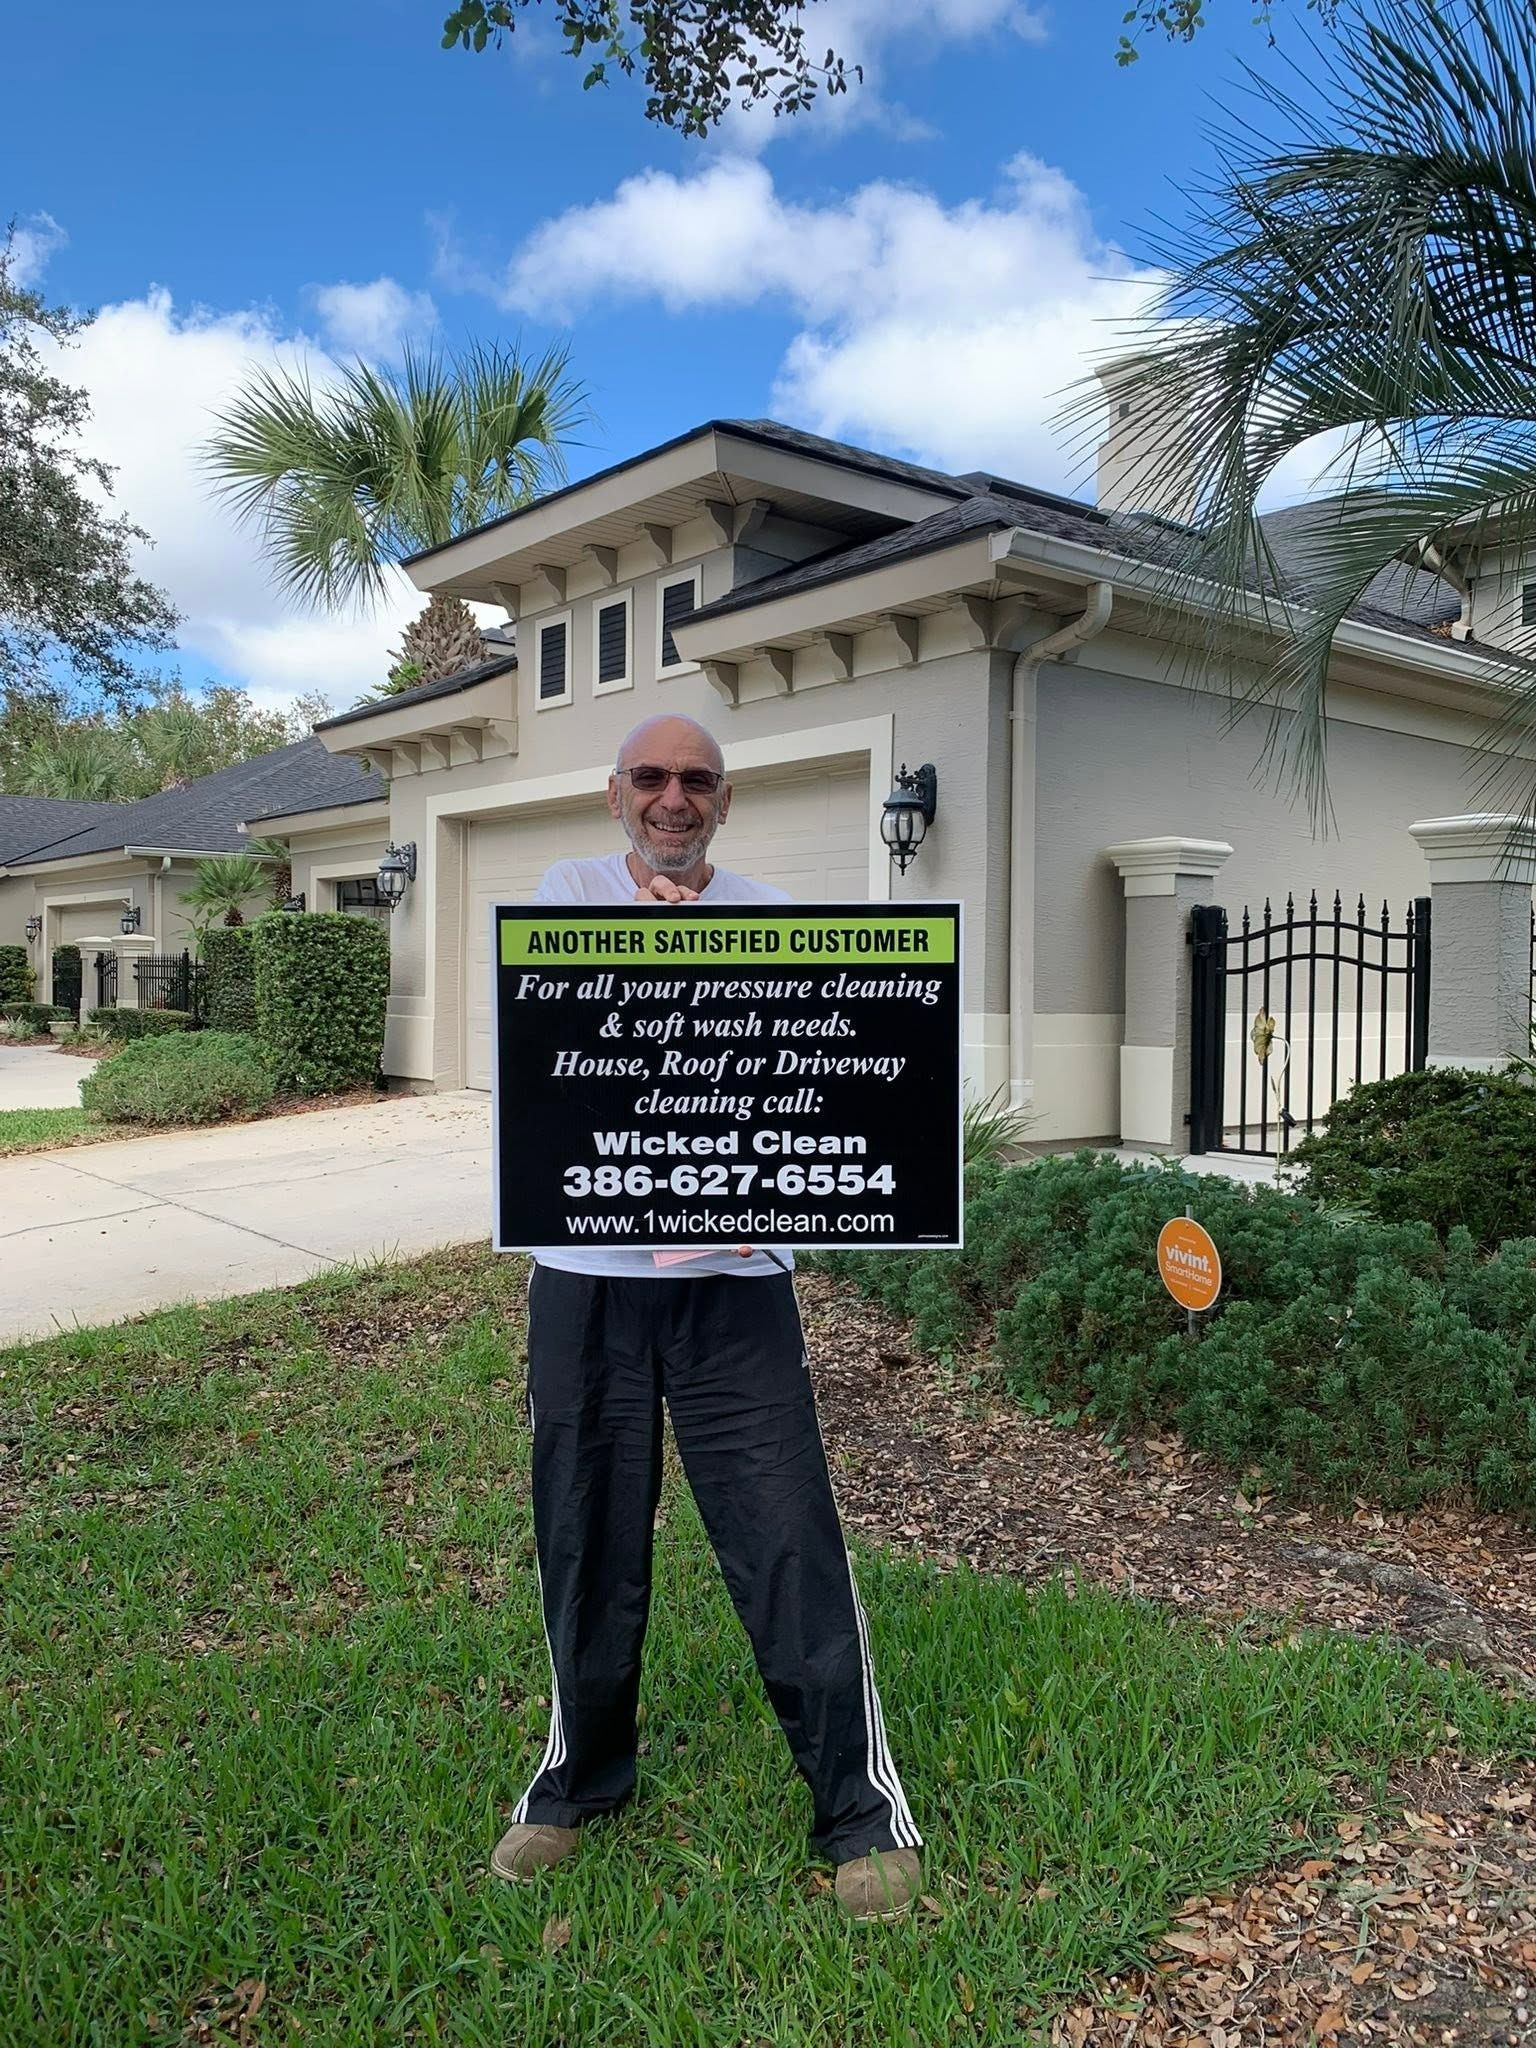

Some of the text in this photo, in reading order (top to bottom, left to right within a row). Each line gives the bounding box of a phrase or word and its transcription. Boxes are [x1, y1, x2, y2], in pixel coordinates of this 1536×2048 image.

[528, 929, 928, 954] ANOTHER SATISFIED CUSTOMER
[515, 973, 942, 1006] For all your pressure cleaning
[600, 1011, 856, 1044] & soft wash needs.
[551, 1050, 905, 1082] House, Roof or Driveway
[635, 1088, 823, 1120] cleaning call:
[593, 1130, 866, 1155] Wicked Clean
[563, 1164, 896, 1197] 386-627-6554
[566, 1209, 894, 1234] www.1wickedclean.com
[1165, 1261, 1213, 1287] SmartHome
